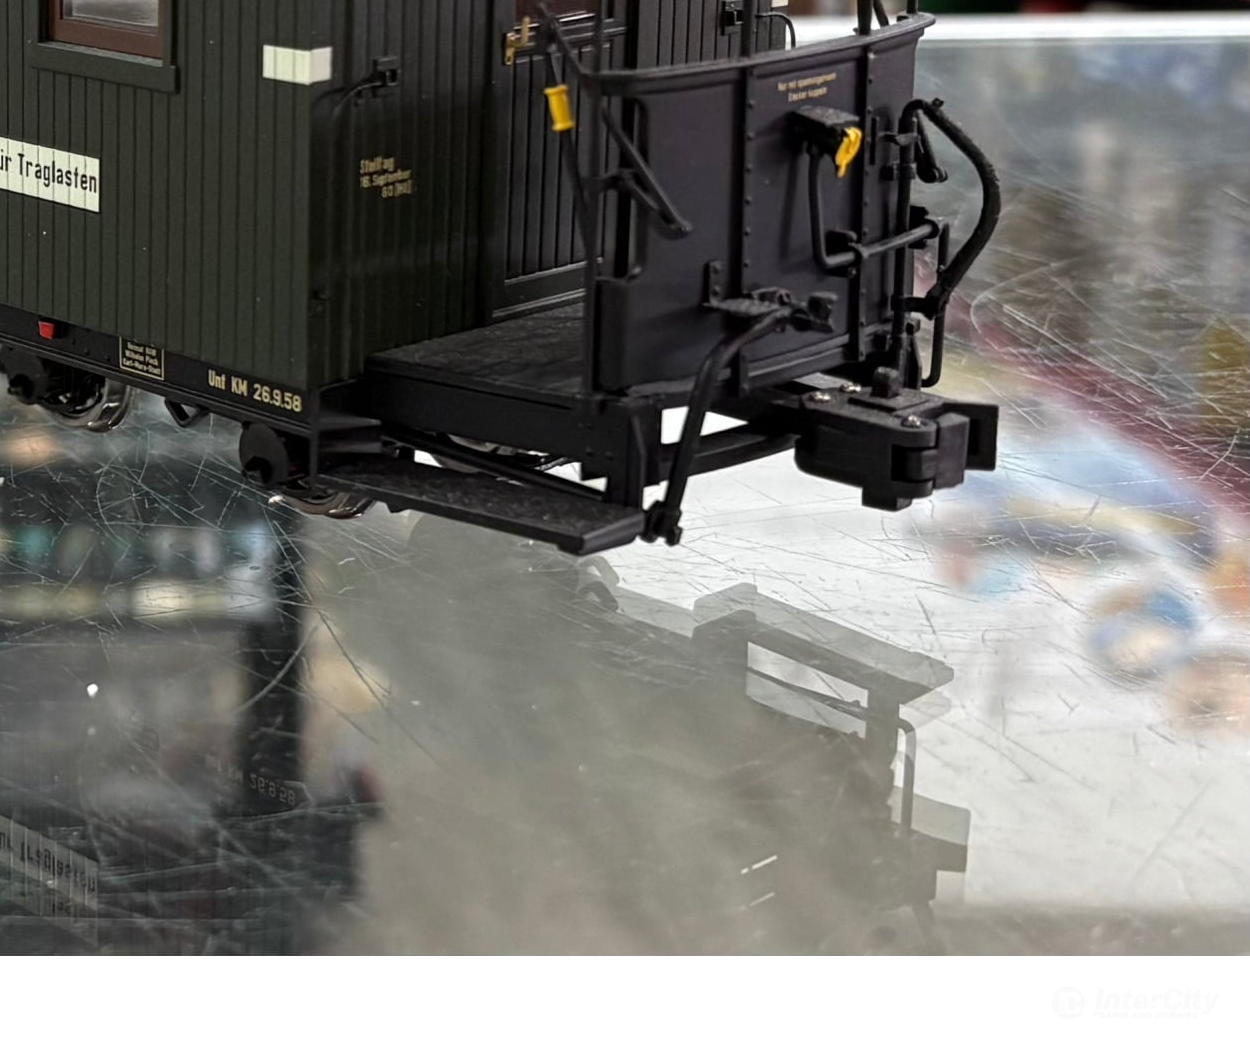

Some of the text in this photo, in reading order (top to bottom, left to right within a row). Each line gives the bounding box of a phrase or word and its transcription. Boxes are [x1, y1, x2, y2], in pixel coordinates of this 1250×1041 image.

[17, 152, 97, 194] Traglasten
[230, 375, 248, 397] KM
[253, 383, 303, 412] 26.9.58
